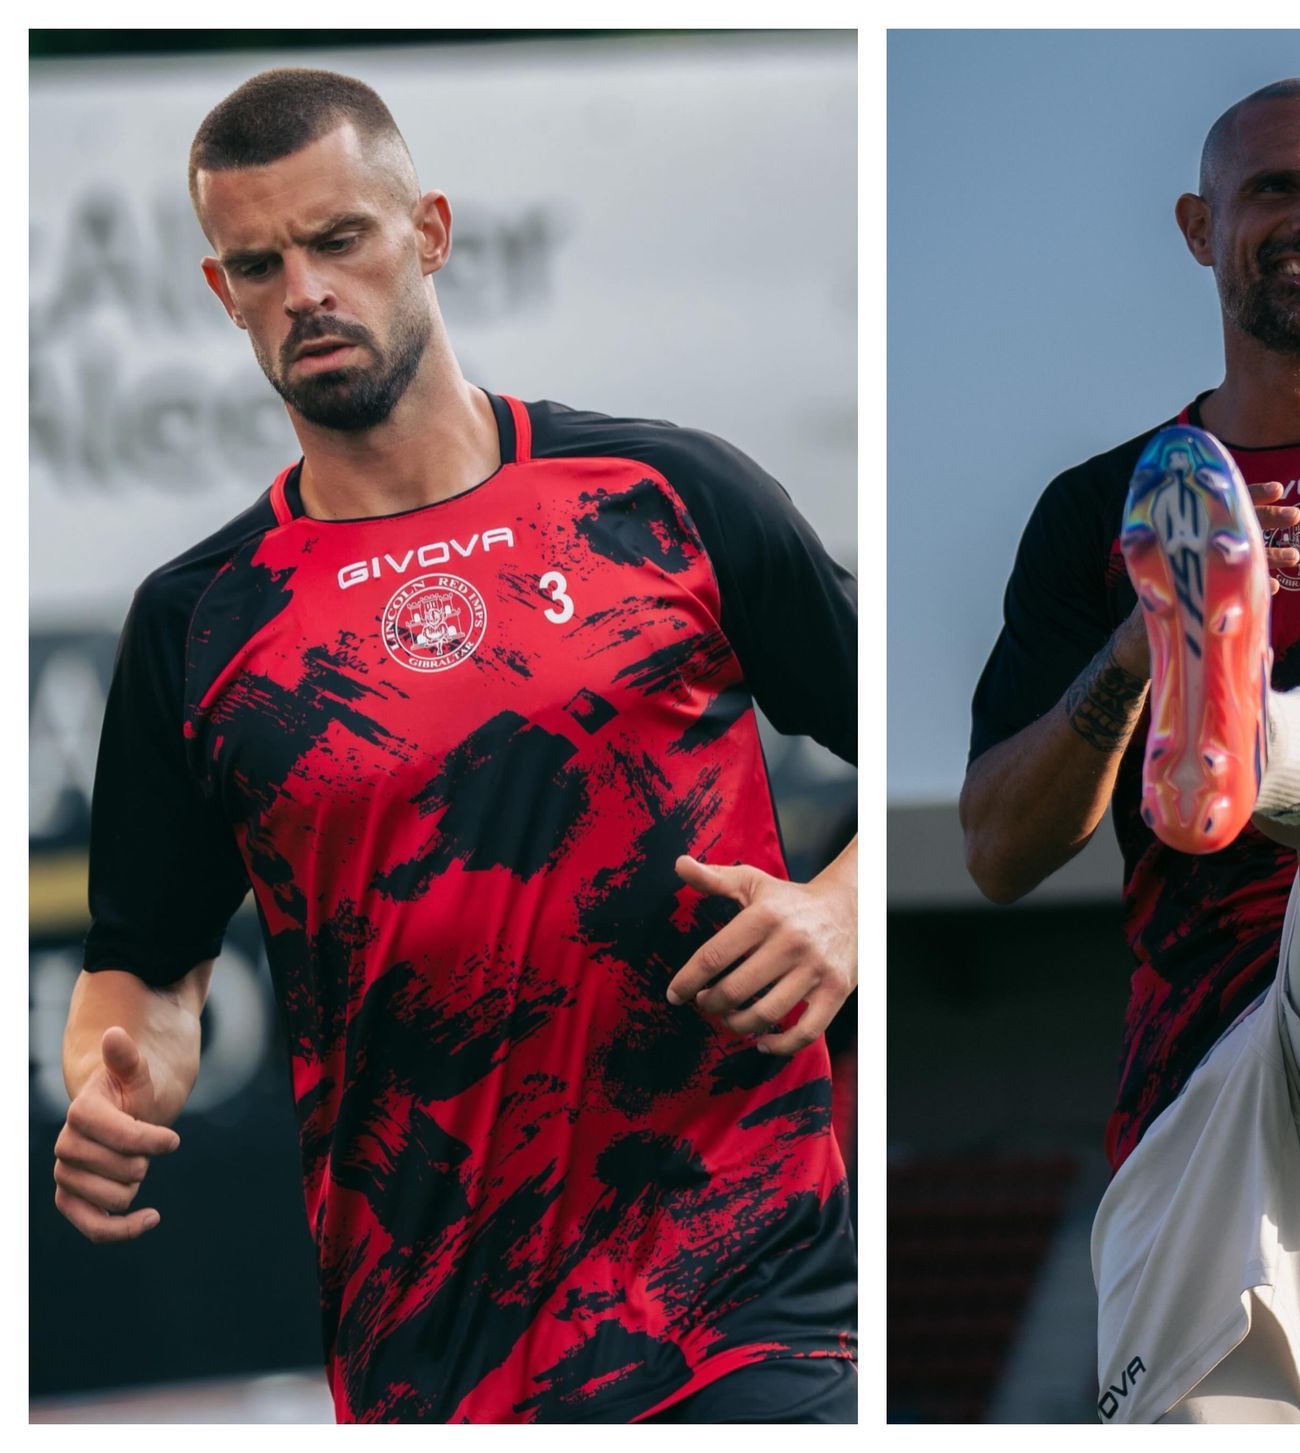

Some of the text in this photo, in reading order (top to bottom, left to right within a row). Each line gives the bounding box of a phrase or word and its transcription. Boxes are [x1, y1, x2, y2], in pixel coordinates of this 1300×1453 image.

[337, 527, 515, 590] GIVOVA
[386, 577, 484, 652] LINCOLN RED IMPS
[539, 571, 575, 624] 3
[408, 640, 475, 668] GIBRALTAR
[1098, 1355, 1146, 1420] OVA
